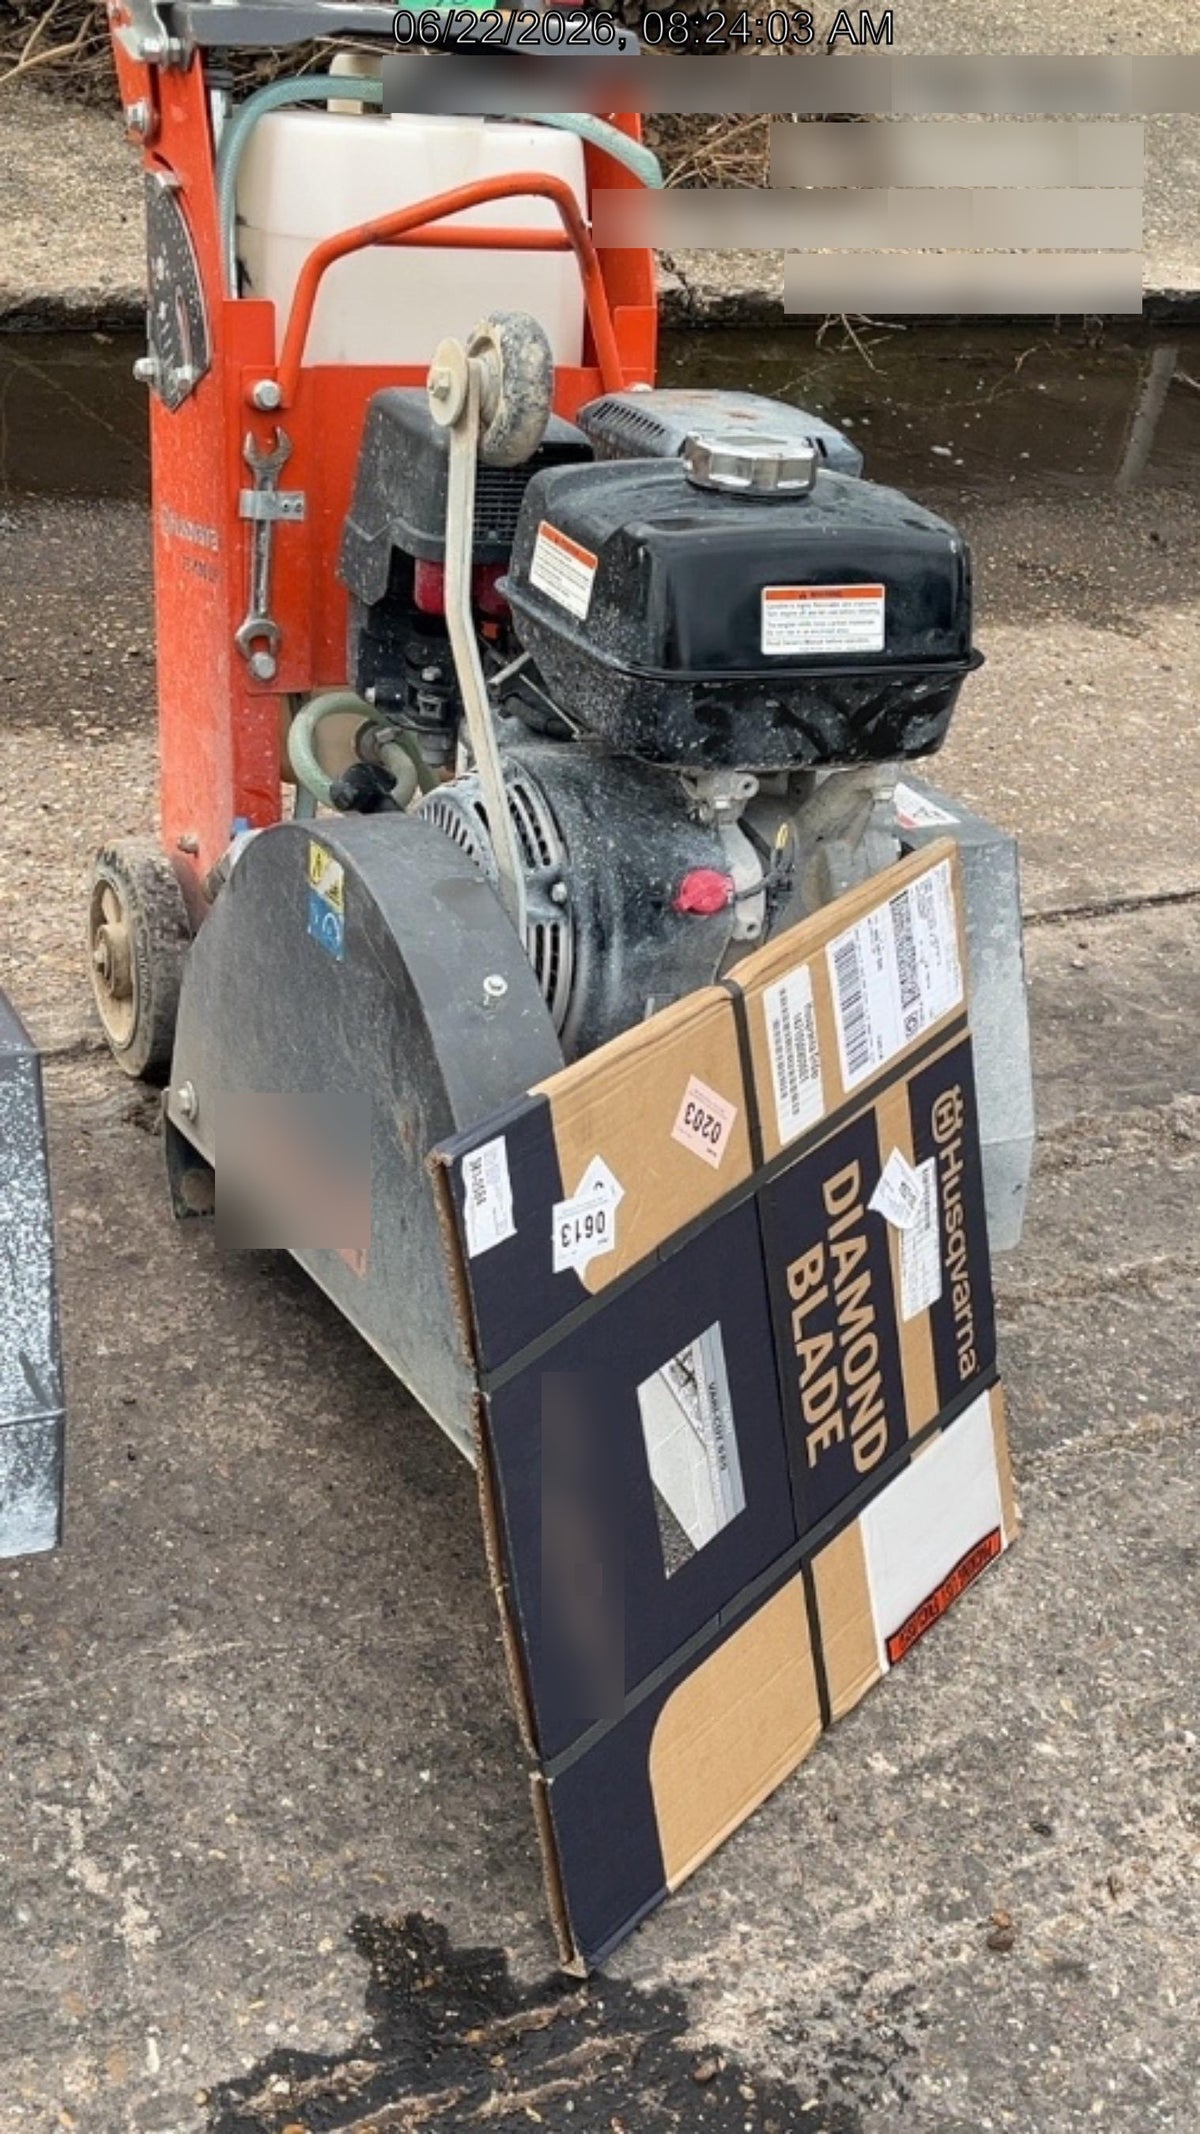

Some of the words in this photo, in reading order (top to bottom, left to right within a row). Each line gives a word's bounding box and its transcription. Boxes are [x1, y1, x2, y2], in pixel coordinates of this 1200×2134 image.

[561, 1210, 606, 1248] 0613
[684, 1101, 723, 1145] 0203
[786, 1241, 845, 1468] BLADE
[822, 1158, 889, 1474] DIAMOND
[936, 1140, 976, 1380] Husqvarna
